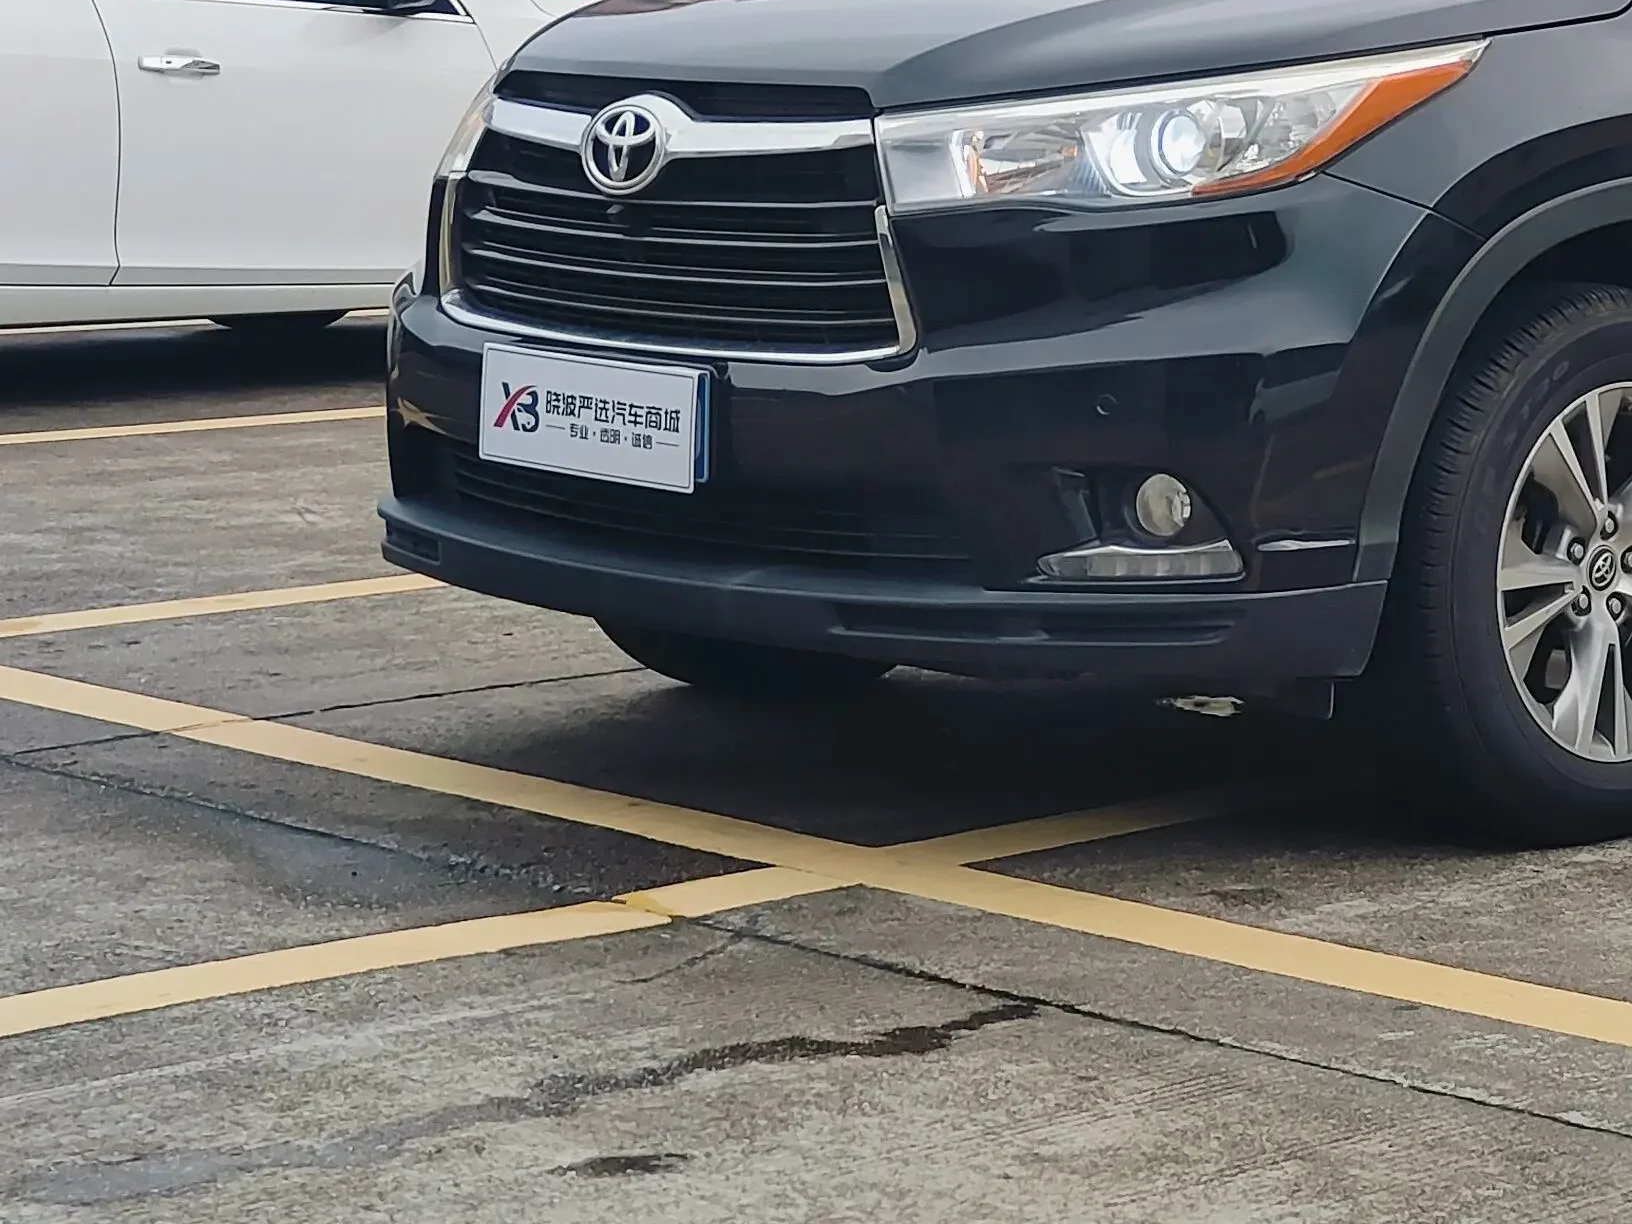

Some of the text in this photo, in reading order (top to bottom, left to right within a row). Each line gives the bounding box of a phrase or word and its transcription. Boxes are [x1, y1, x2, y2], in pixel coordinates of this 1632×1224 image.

[545, 389, 681, 434] 晓波严选汽车商城
